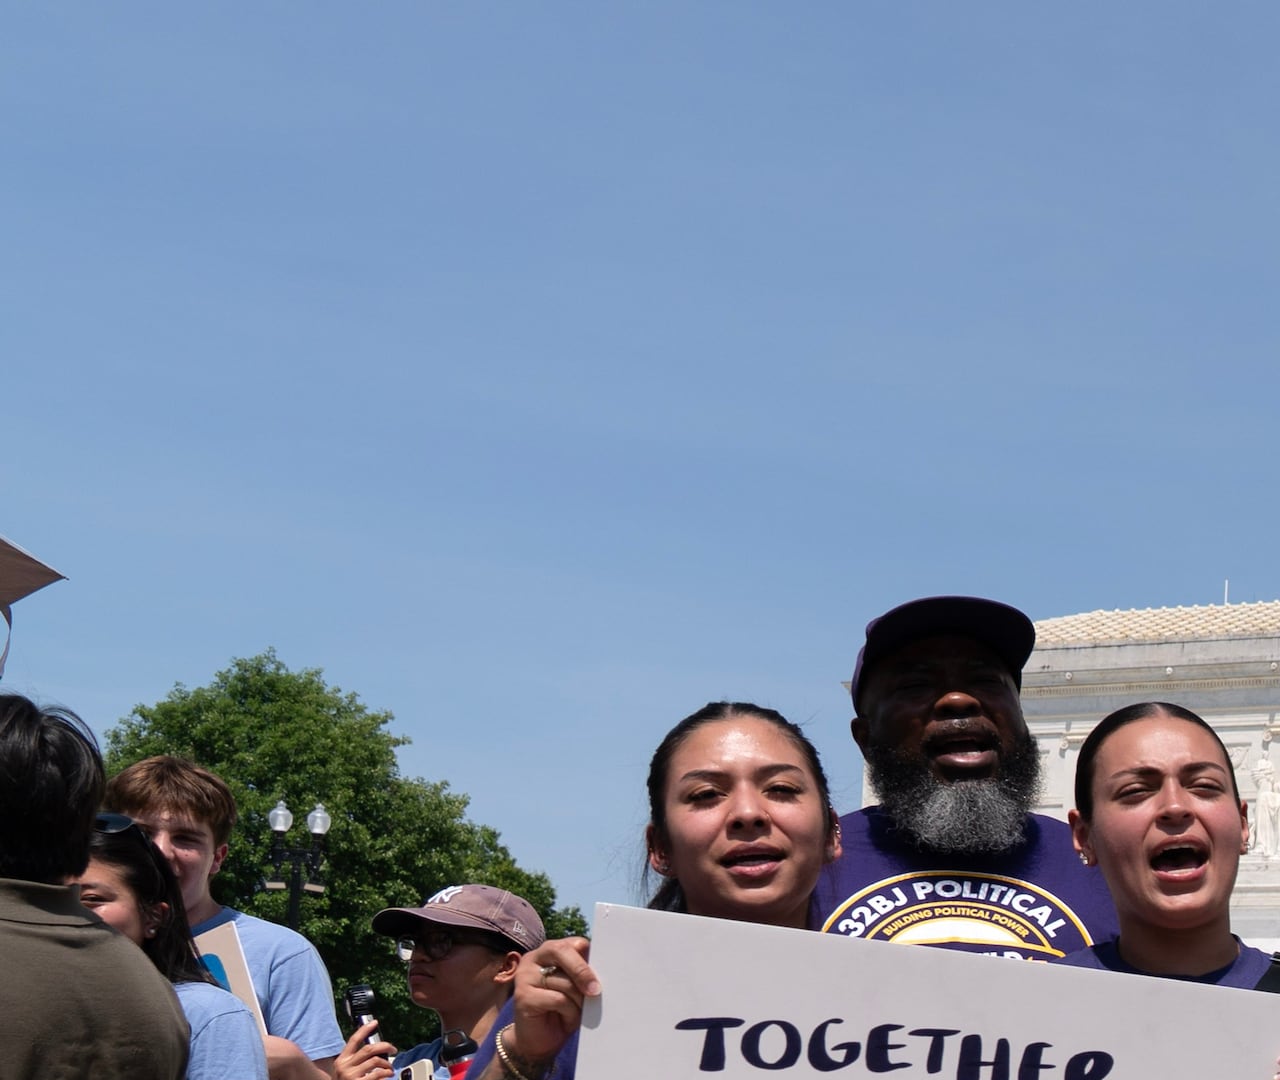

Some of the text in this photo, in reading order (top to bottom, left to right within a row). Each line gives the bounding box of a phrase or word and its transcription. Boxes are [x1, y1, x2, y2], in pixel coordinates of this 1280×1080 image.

[838, 880, 1067, 938] 32BJ POLITICAL
[882, 907, 1029, 939] BUILDING POLITICAL POWER
